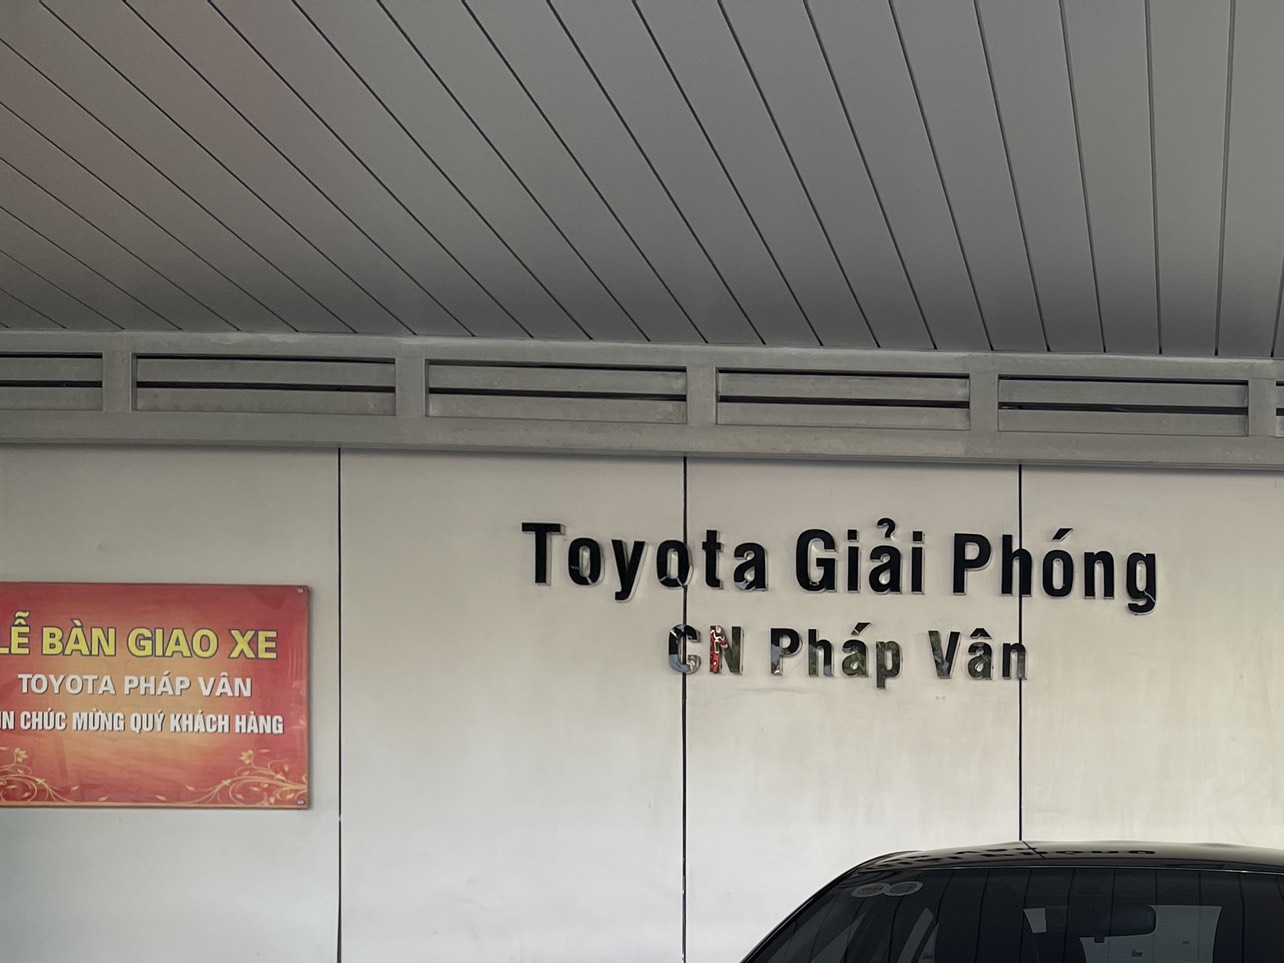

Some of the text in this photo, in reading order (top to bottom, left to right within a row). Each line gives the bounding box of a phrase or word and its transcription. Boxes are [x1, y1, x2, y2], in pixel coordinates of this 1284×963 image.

[521, 517, 1158, 615] Toyota Giải Phóng
[41, 618, 116, 656] BÀN
[127, 627, 219, 657] GIAO
[228, 629, 278, 659] XE
[667, 622, 1028, 688] CN Pháp Vân
[17, 671, 252, 697] TOYOTA PHÁP VÂN
[20, 707, 67, 730] CHÚC
[72, 707, 125, 731] MỪNG
[130, 709, 165, 733] QUÝ
[169, 710, 230, 733] KHÁCH
[235, 710, 284, 734] HÀNG
